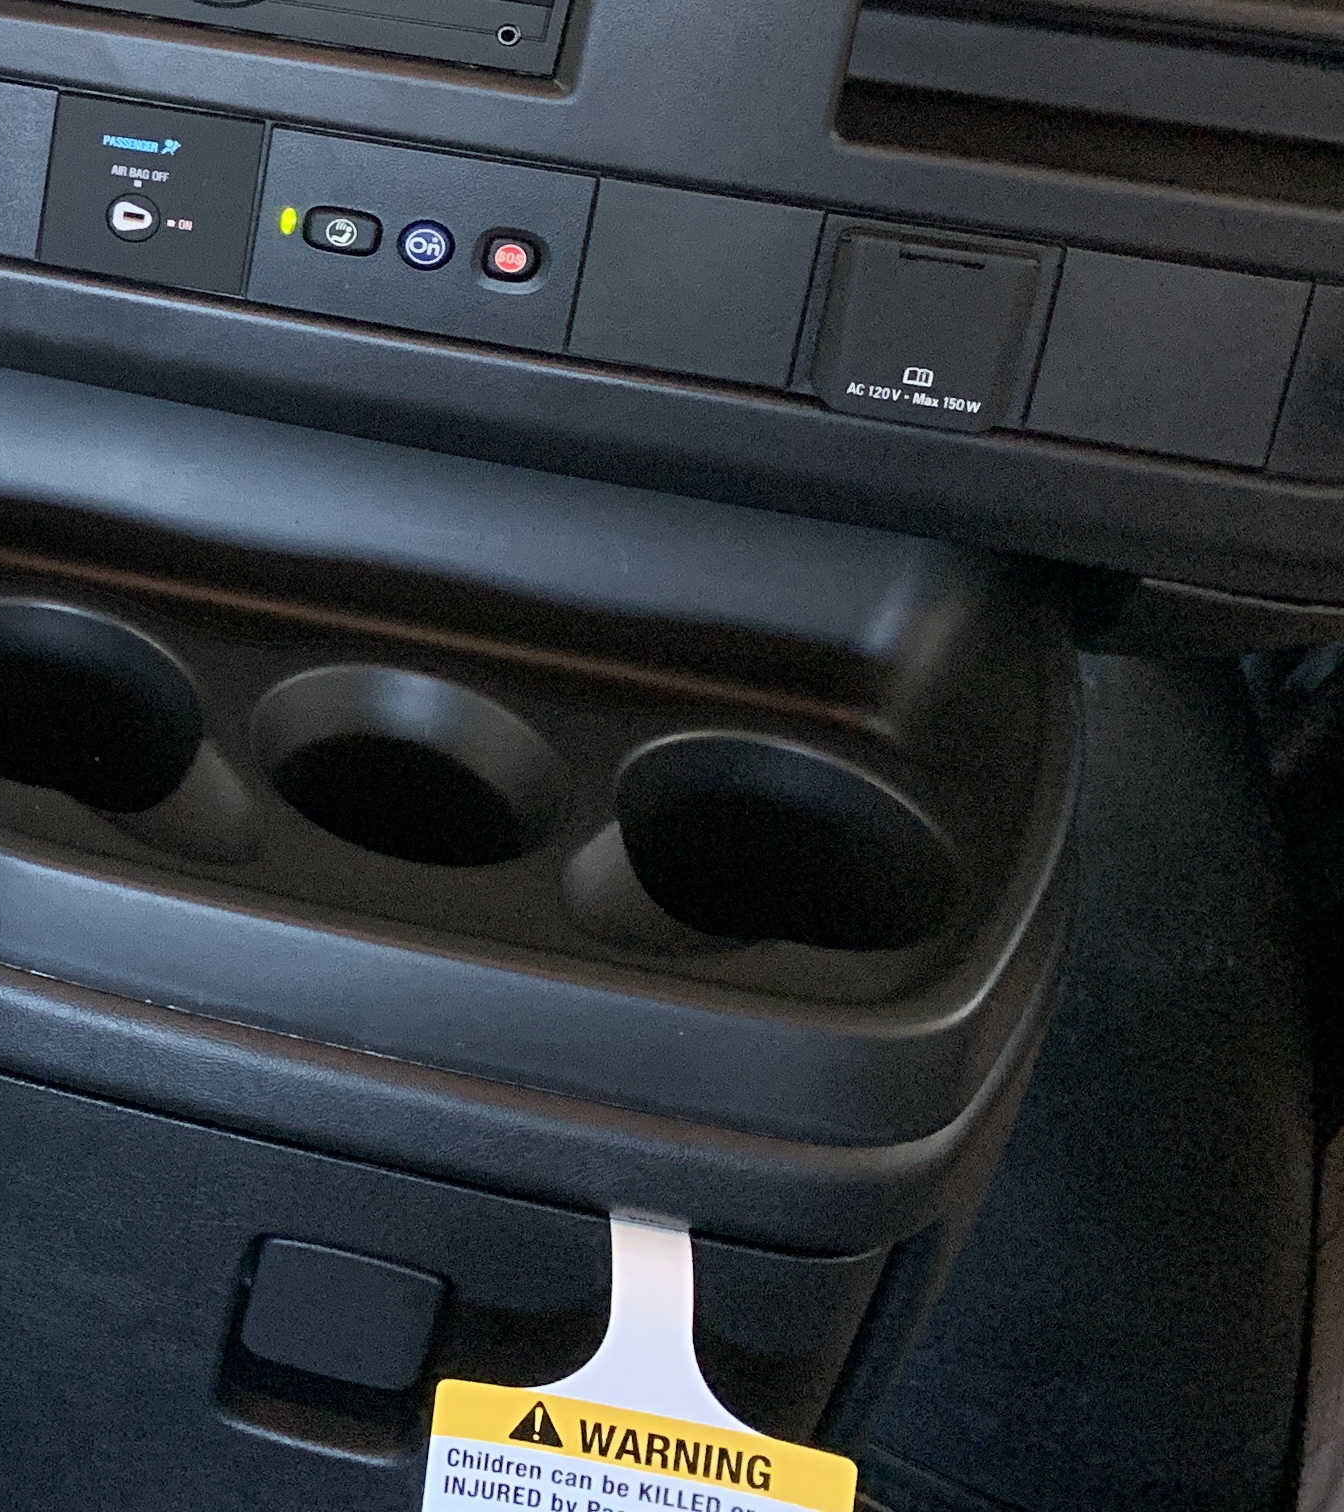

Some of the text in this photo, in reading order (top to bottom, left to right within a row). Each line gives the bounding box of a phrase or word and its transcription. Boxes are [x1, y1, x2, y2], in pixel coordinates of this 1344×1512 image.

[103, 135, 159, 153] PASSENGER
[111, 164, 170, 183] AIR BAG OFF
[177, 219, 193, 231] ON
[497, 251, 524, 266] SOS
[846, 382, 865, 396] AC
[912, 392, 940, 408] Max
[579, 1419, 773, 1492] WARNING
[447, 1448, 542, 1480] Children
[551, 1468, 592, 1490] can
[602, 1475, 629, 1498] be
[638, 1482, 721, 1512] KILLED
[444, 1475, 542, 1509] INJURED
[551, 1493, 578, 1512] by
